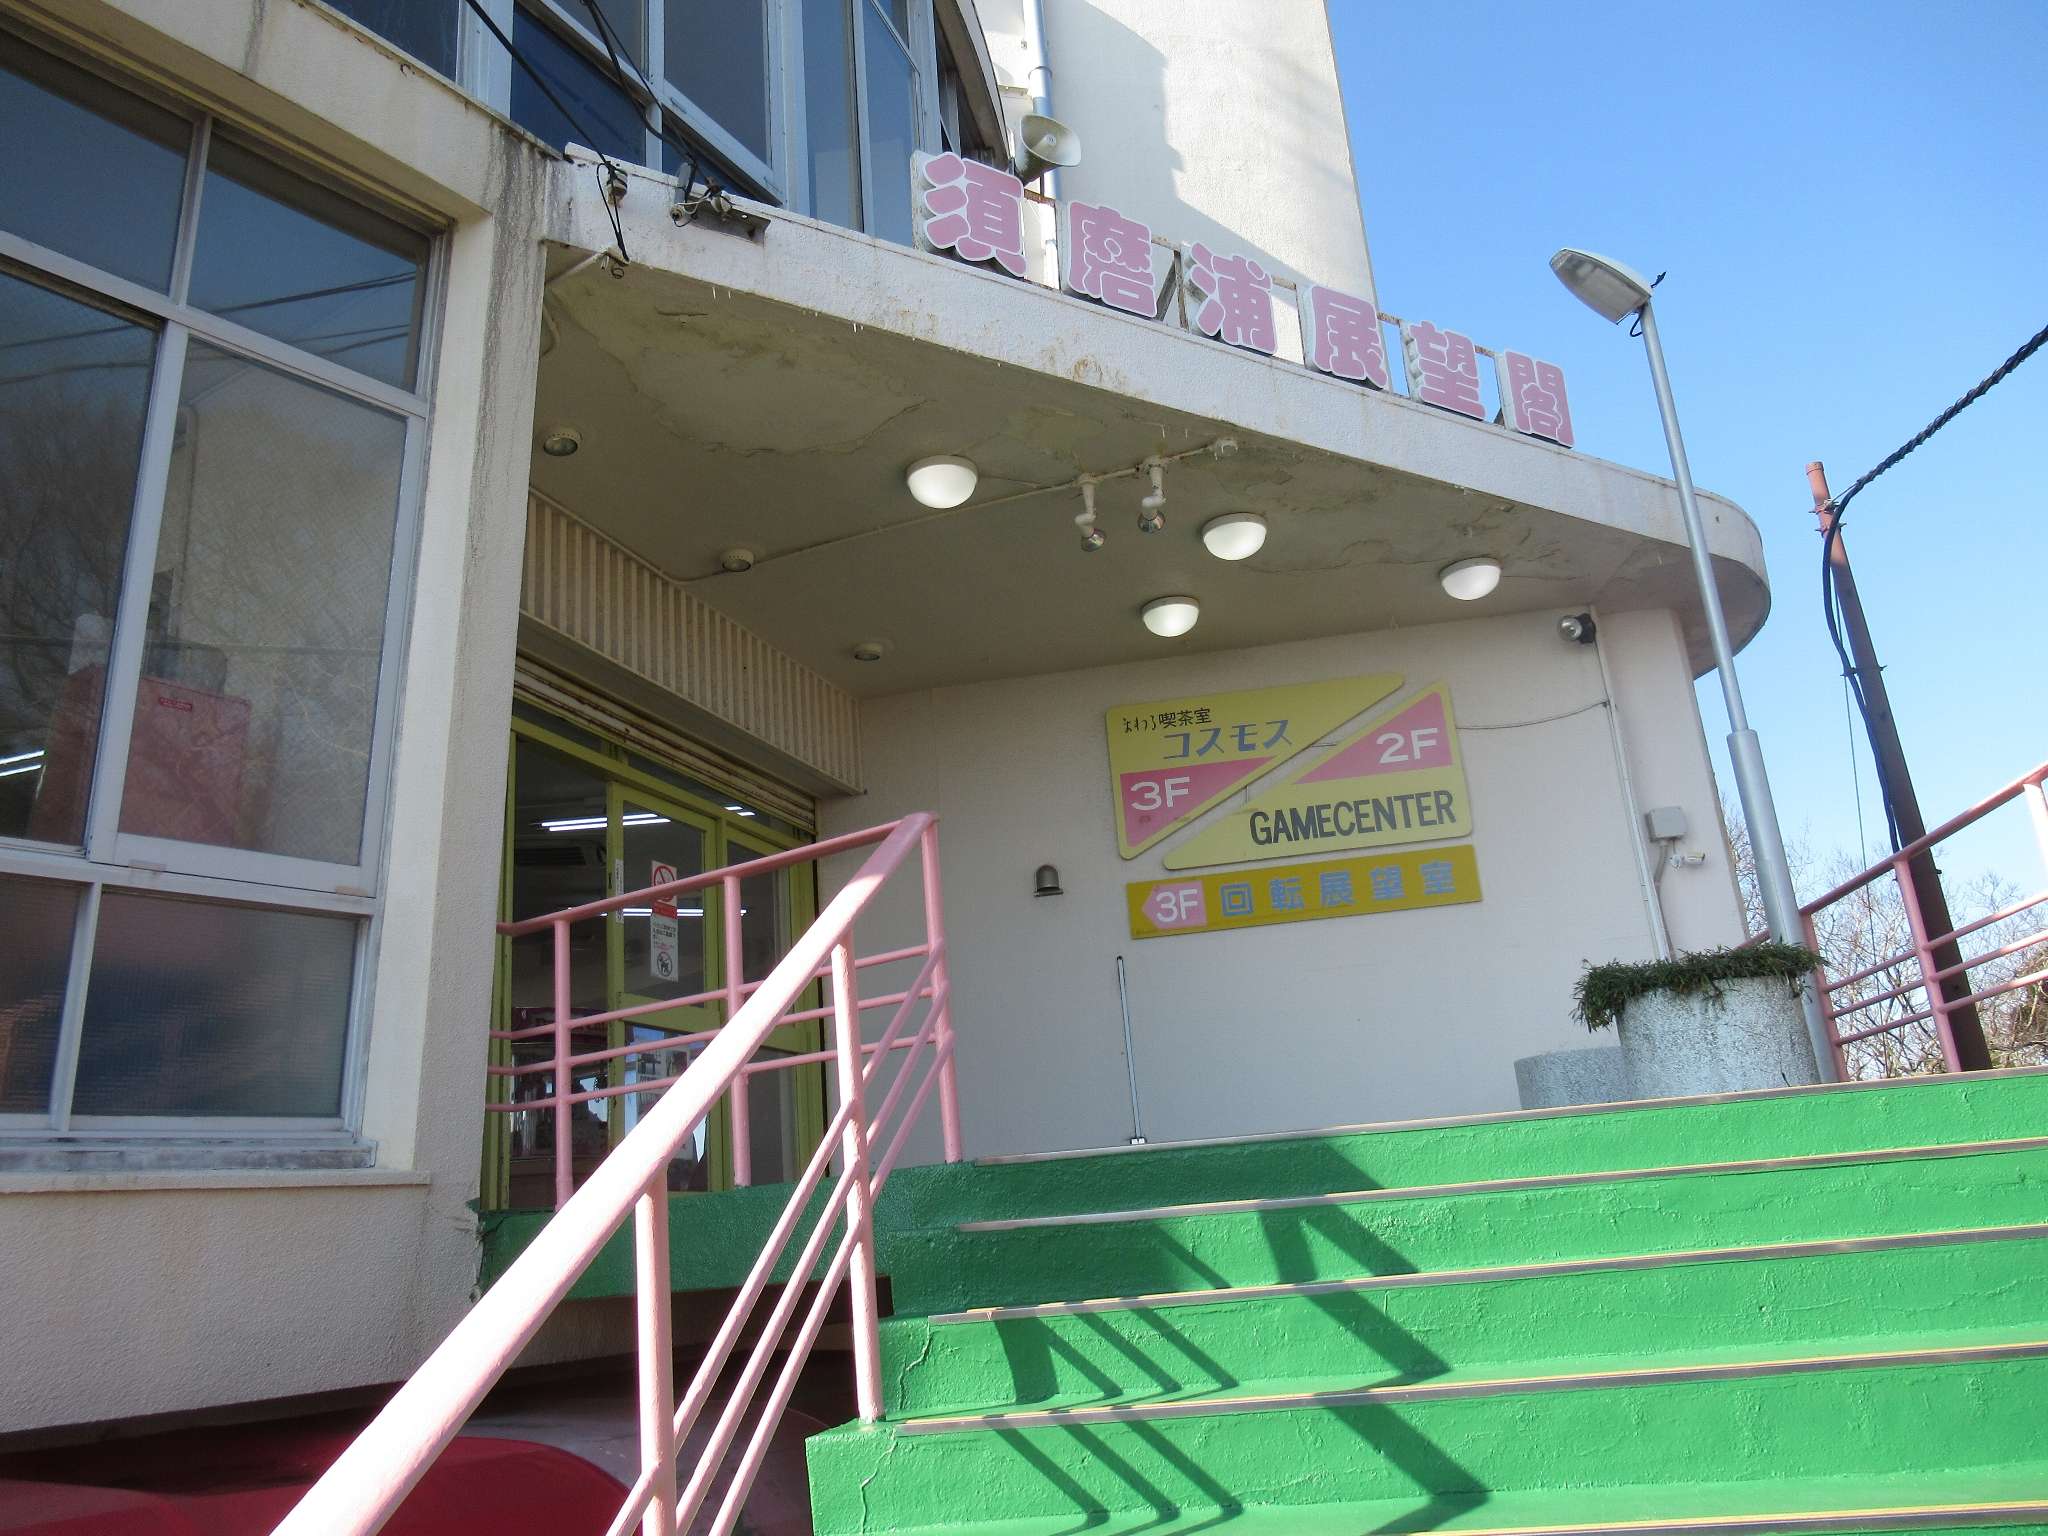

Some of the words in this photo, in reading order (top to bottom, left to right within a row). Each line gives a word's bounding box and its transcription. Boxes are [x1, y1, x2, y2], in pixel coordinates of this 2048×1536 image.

[923, 151, 1575, 448] 須磨浦展望閣
[1162, 719, 1293, 760] コスモス
[1375, 727, 1439, 765] 2F
[1130, 776, 1192, 812] 3F
[1249, 789, 1457, 846] GAMECENTER
[1155, 888, 1199, 924] 3F
[1219, 861, 1457, 917] 回転展望室
